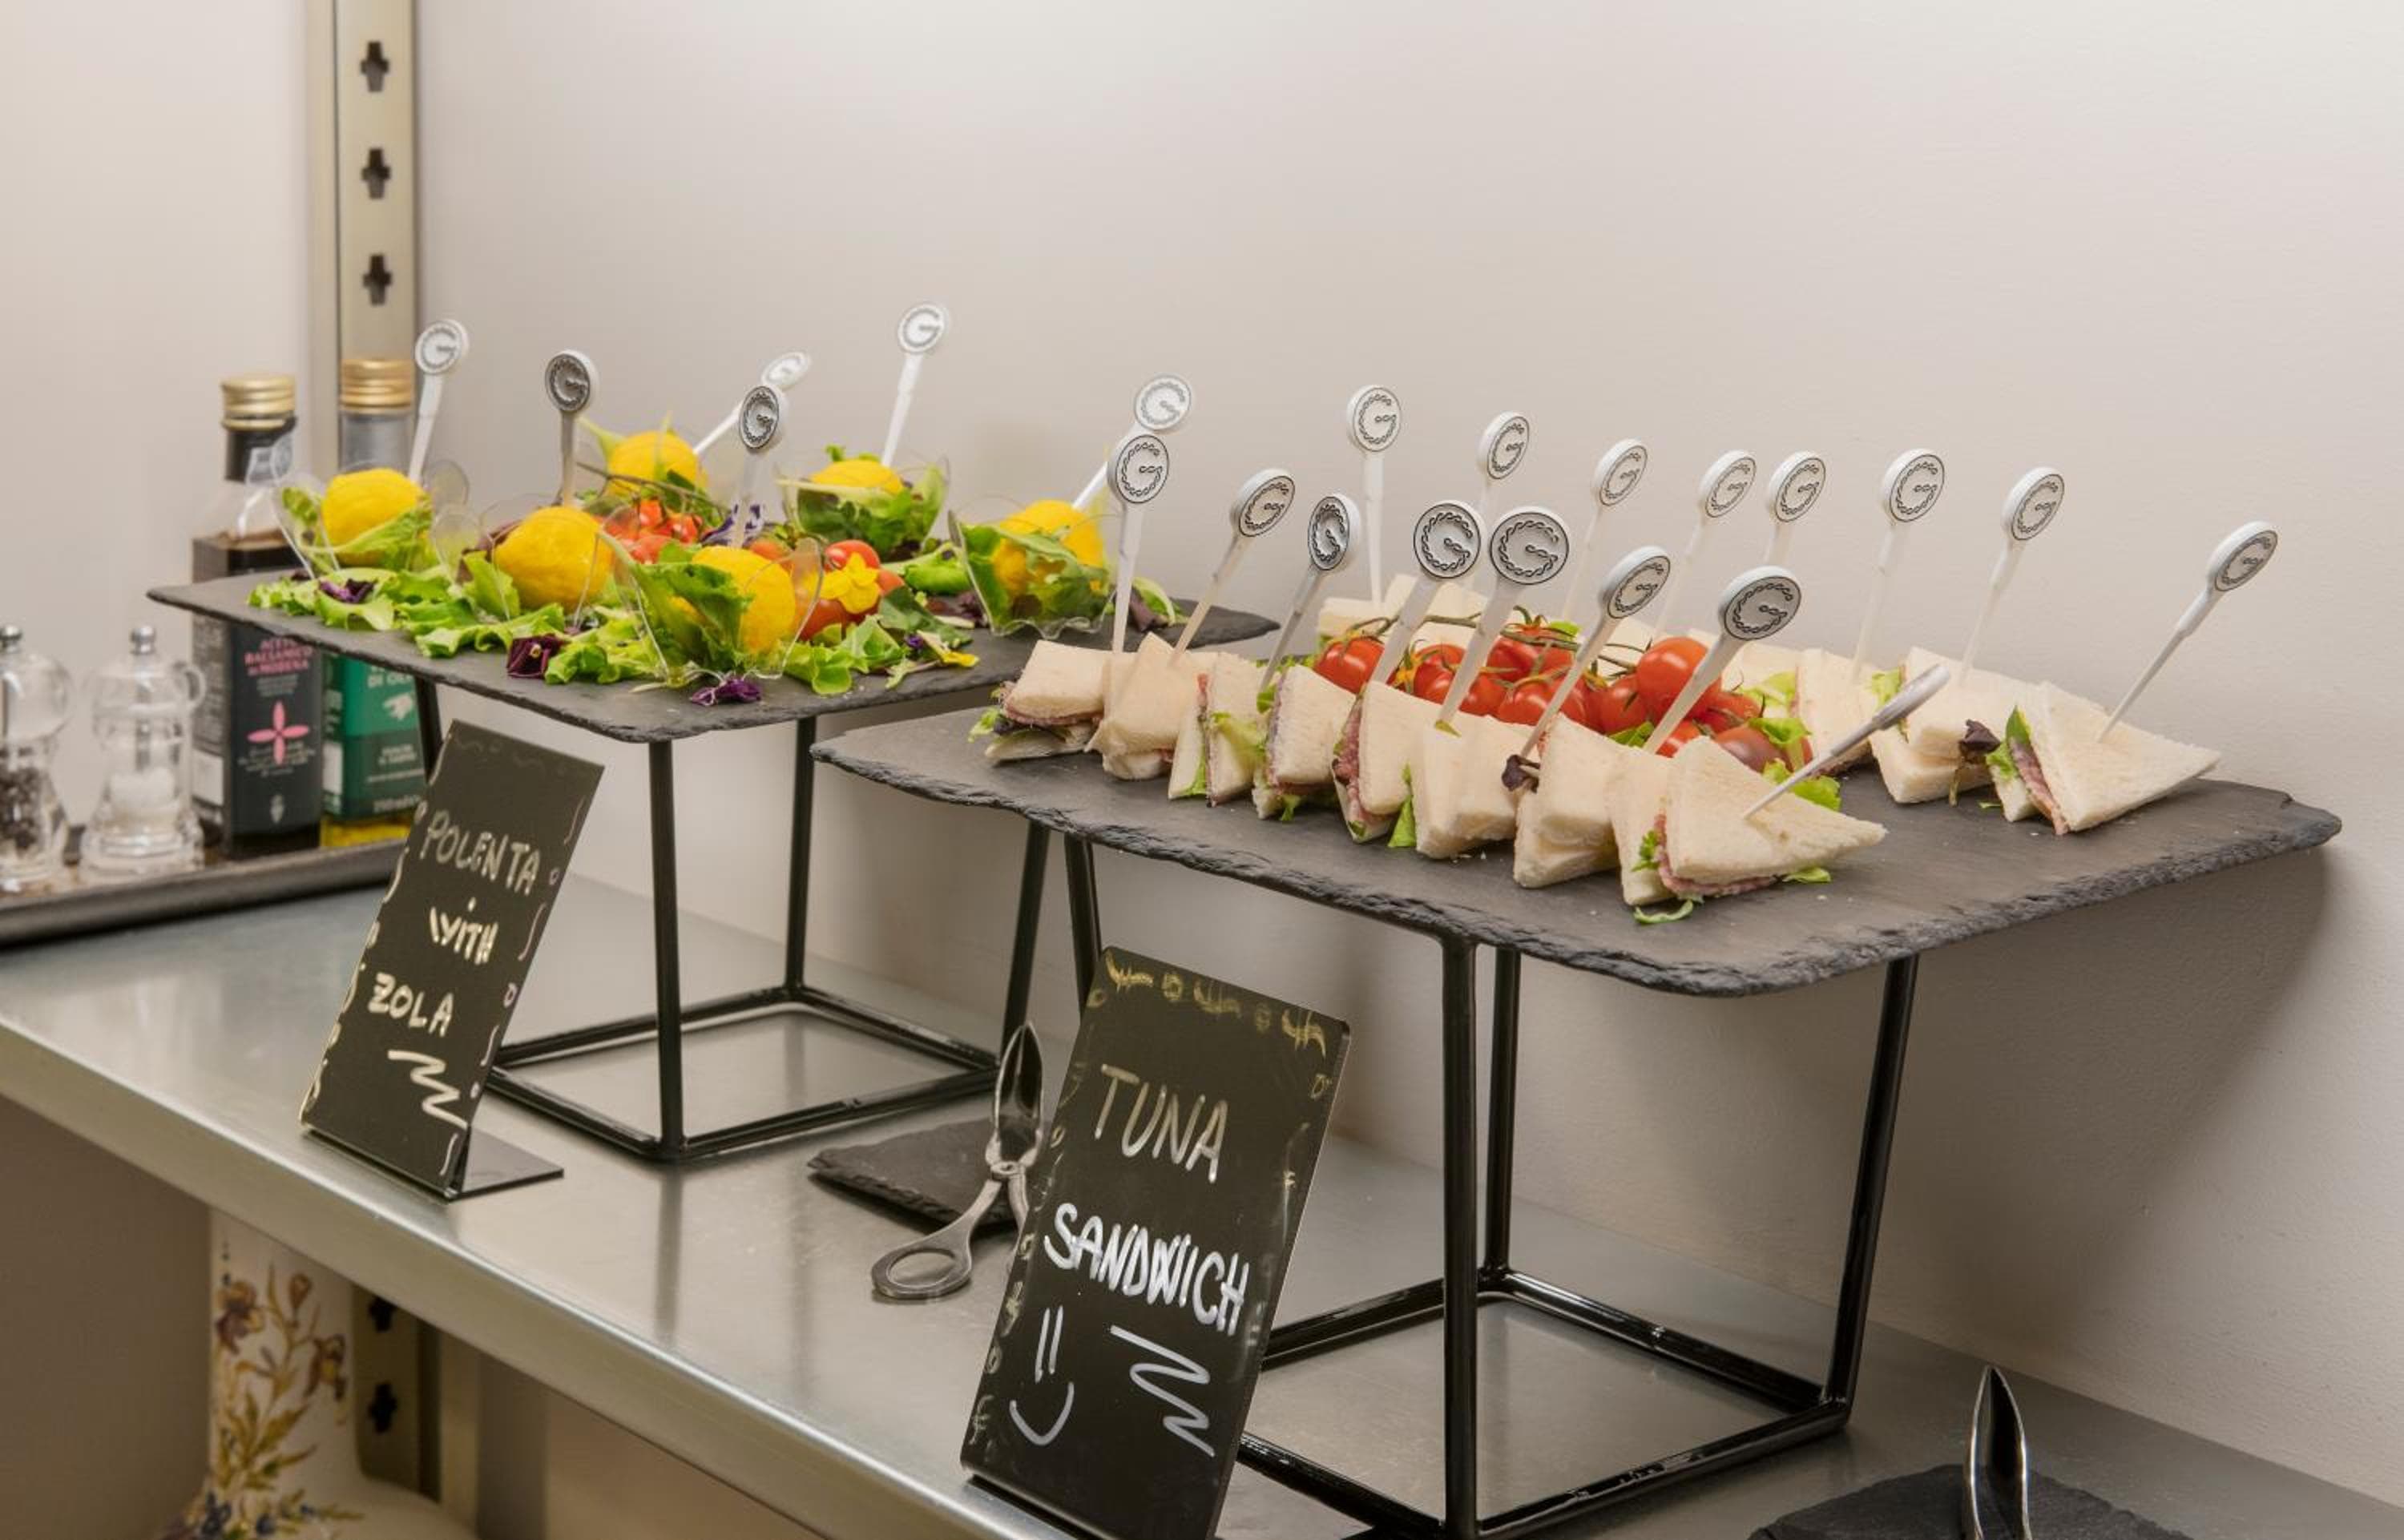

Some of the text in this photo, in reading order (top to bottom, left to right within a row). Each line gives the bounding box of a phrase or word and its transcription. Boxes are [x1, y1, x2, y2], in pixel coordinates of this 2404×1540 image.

[1358, 393, 1397, 445] G
[1121, 441, 1163, 497] G
[1491, 422, 1525, 474] G
[1244, 481, 1289, 533] G
[1780, 463, 1820, 515] G
[1895, 461, 1938, 515] G
[2016, 481, 2059, 534] G
[1421, 510, 1474, 572] G
[1498, 519, 1559, 579] G
[1614, 562, 1664, 613] G
[1732, 582, 1794, 634] G
[419, 810, 541, 895] POLENTA
[429, 896, 498, 965] WITH
[367, 972, 454, 1037] ZOLA
[1094, 1063, 1229, 1183] TUNA
[1043, 1203, 1250, 1336] SANDWICH
